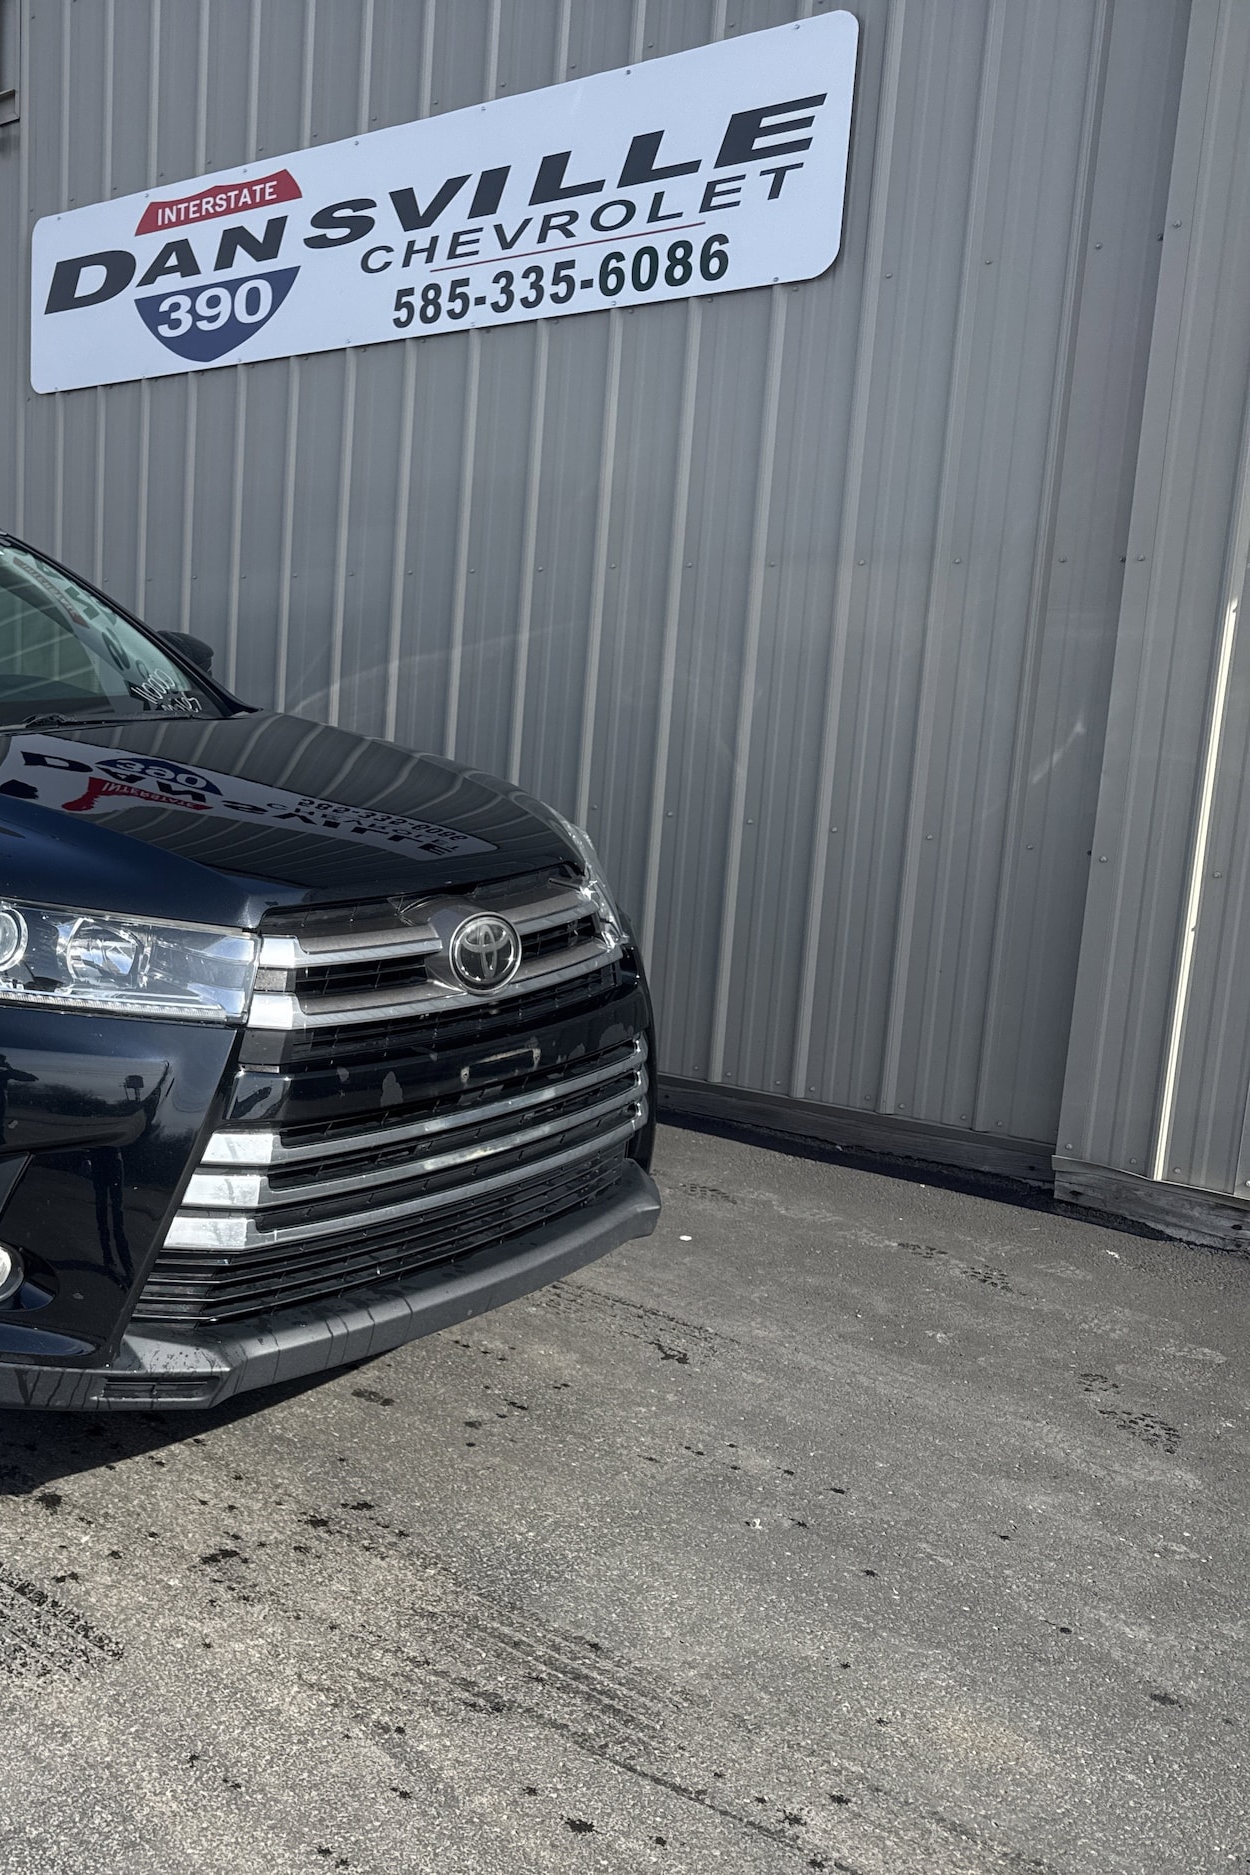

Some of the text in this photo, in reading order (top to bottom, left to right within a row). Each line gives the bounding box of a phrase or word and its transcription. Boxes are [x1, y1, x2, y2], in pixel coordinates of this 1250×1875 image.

[156, 179, 278, 227] INTERSTATE
[360, 163, 805, 275] CHEVROLET
[156, 278, 274, 339] 390
[392, 233, 730, 330] 585-335-6086
